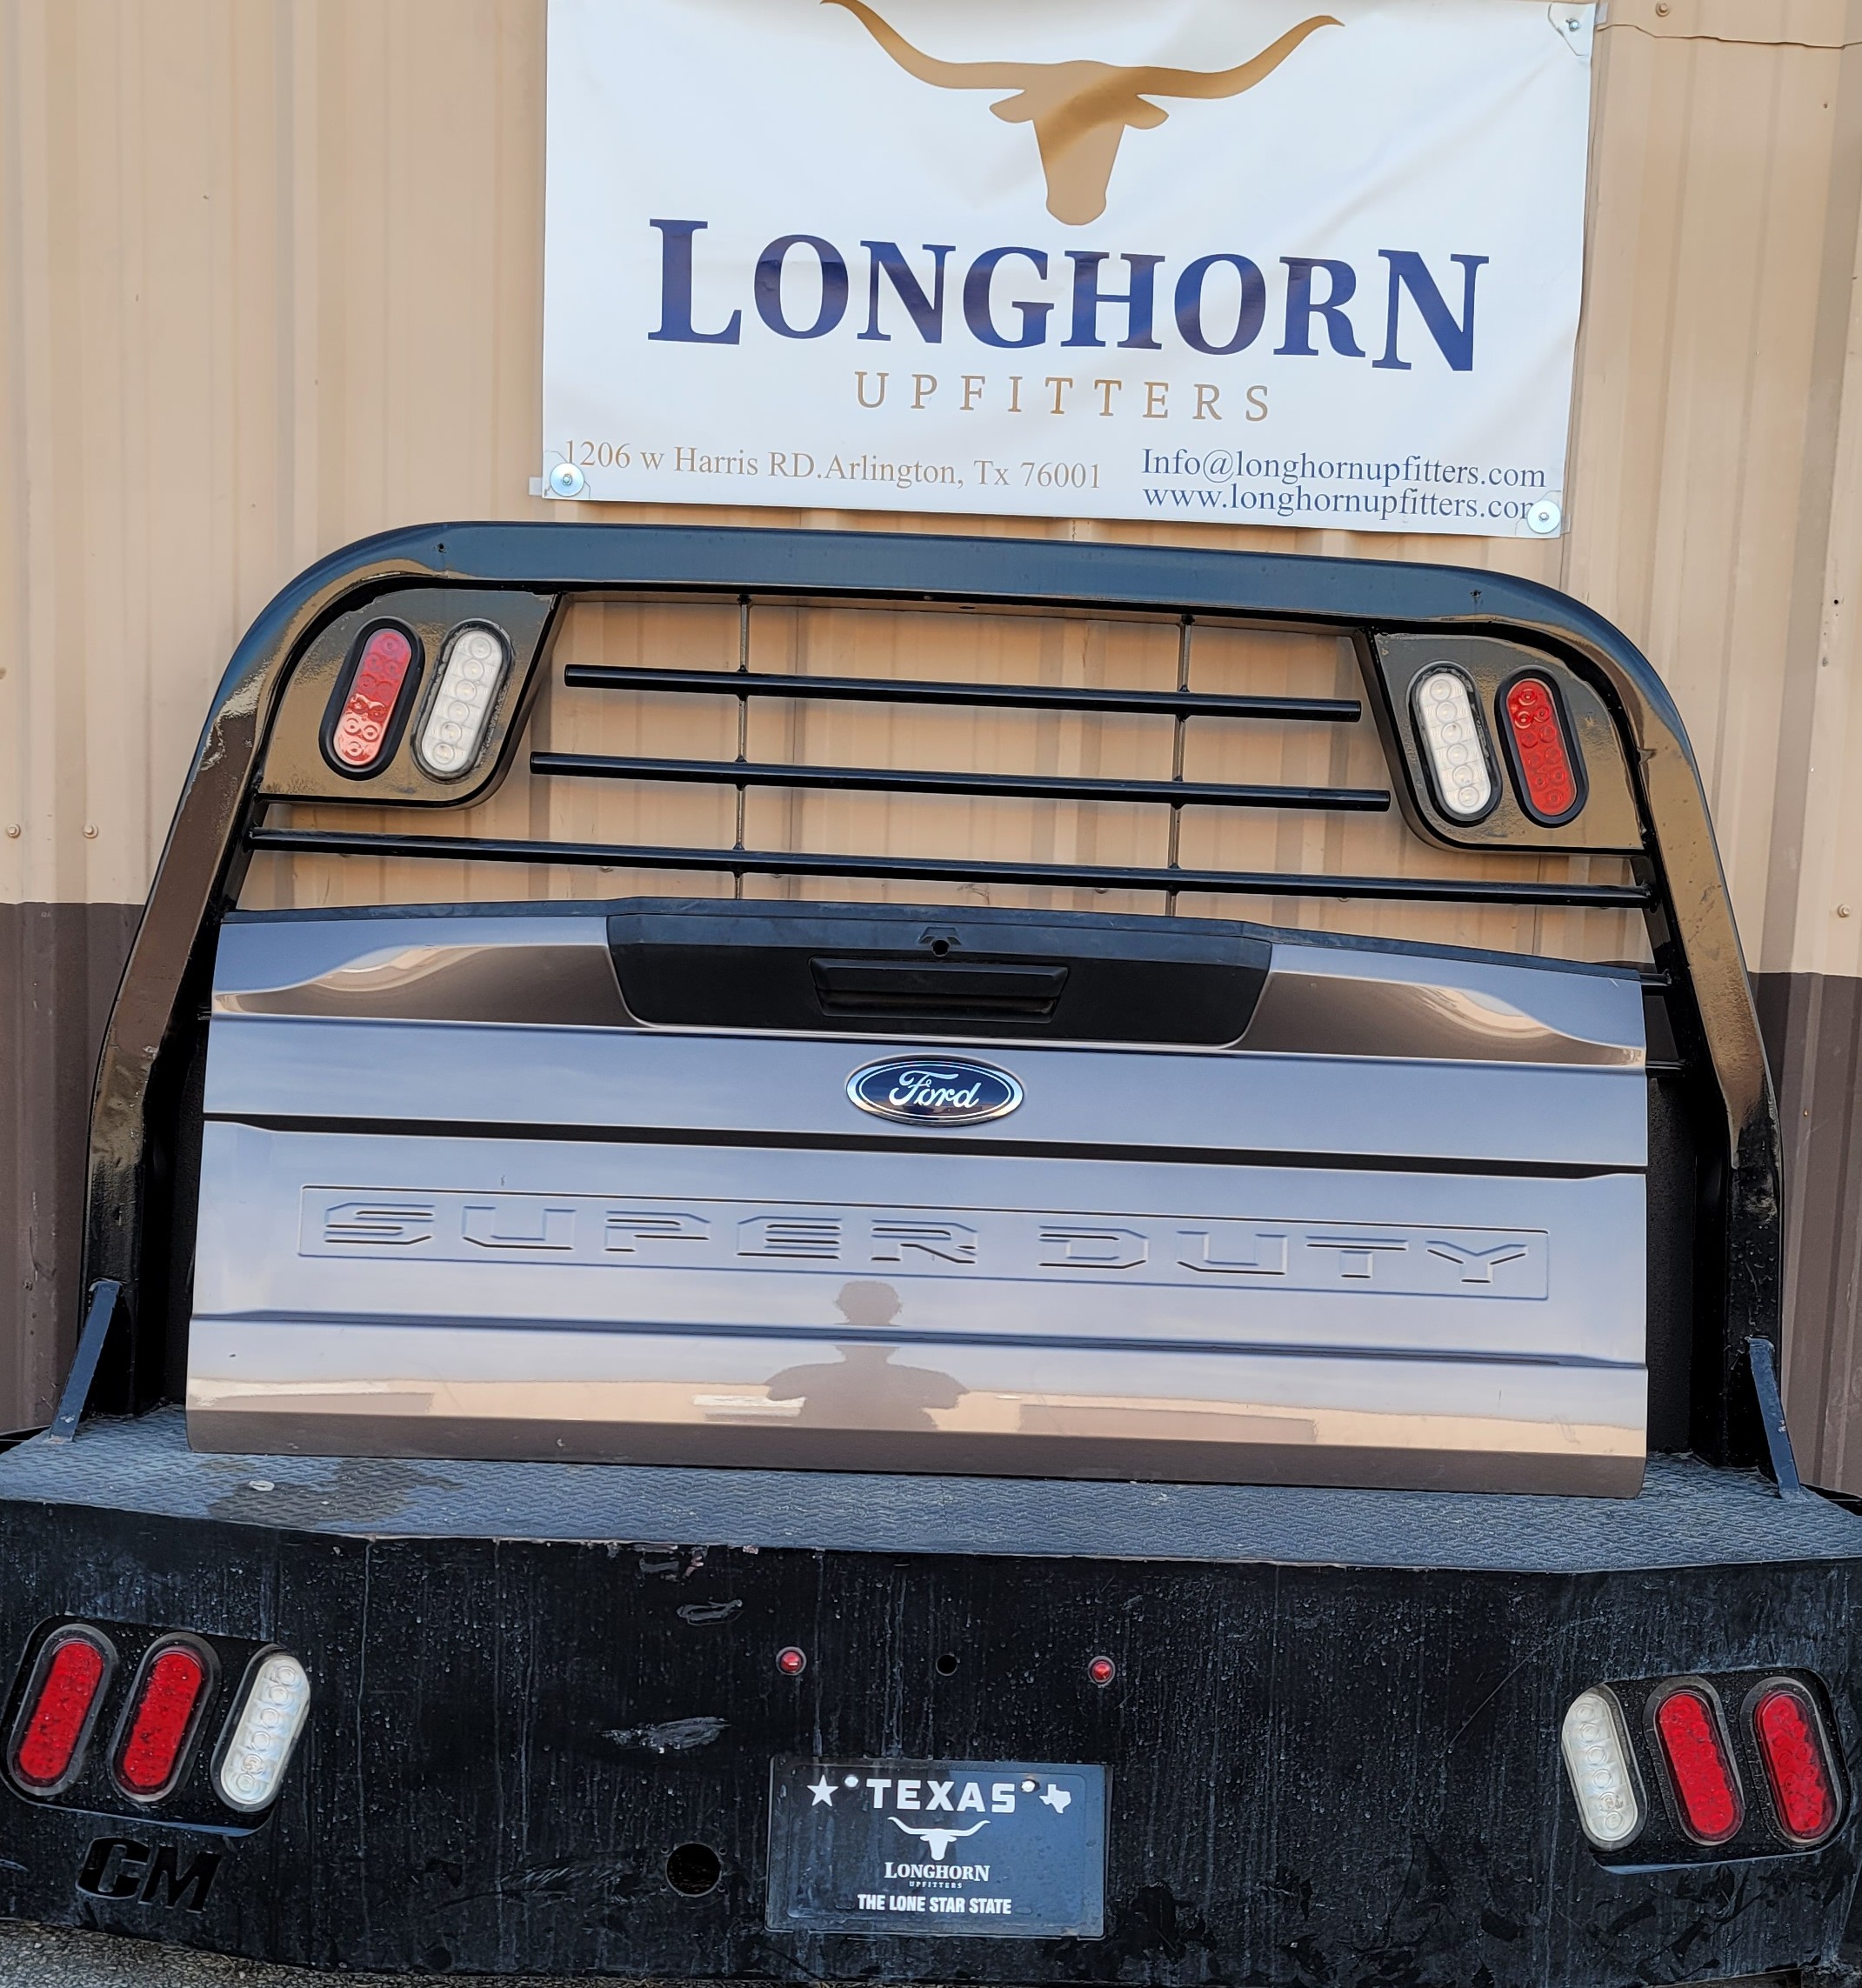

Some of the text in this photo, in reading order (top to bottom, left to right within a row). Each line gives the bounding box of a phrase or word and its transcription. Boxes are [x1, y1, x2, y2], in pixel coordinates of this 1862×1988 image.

[647, 218, 1490, 372] LONGHORN
[854, 371, 1269, 422] UPFITTERS
[565, 439, 1100, 490] 1206 w Harris RD.Arlington, Tx 76001
[1141, 448, 1547, 488] Info@longhornupfitters.com
[888, 1070, 982, 1109] Ford
[324, 1201, 1528, 1284] SUPER DUTY
[865, 1778, 1016, 1814] TEXAS
[75, 1836, 223, 1914] CM
[883, 1861, 991, 1882] LONGHORN
[908, 1880, 963, 1889] UPFITTERS
[857, 1893, 1012, 1915] THE LONE STAR STATE
